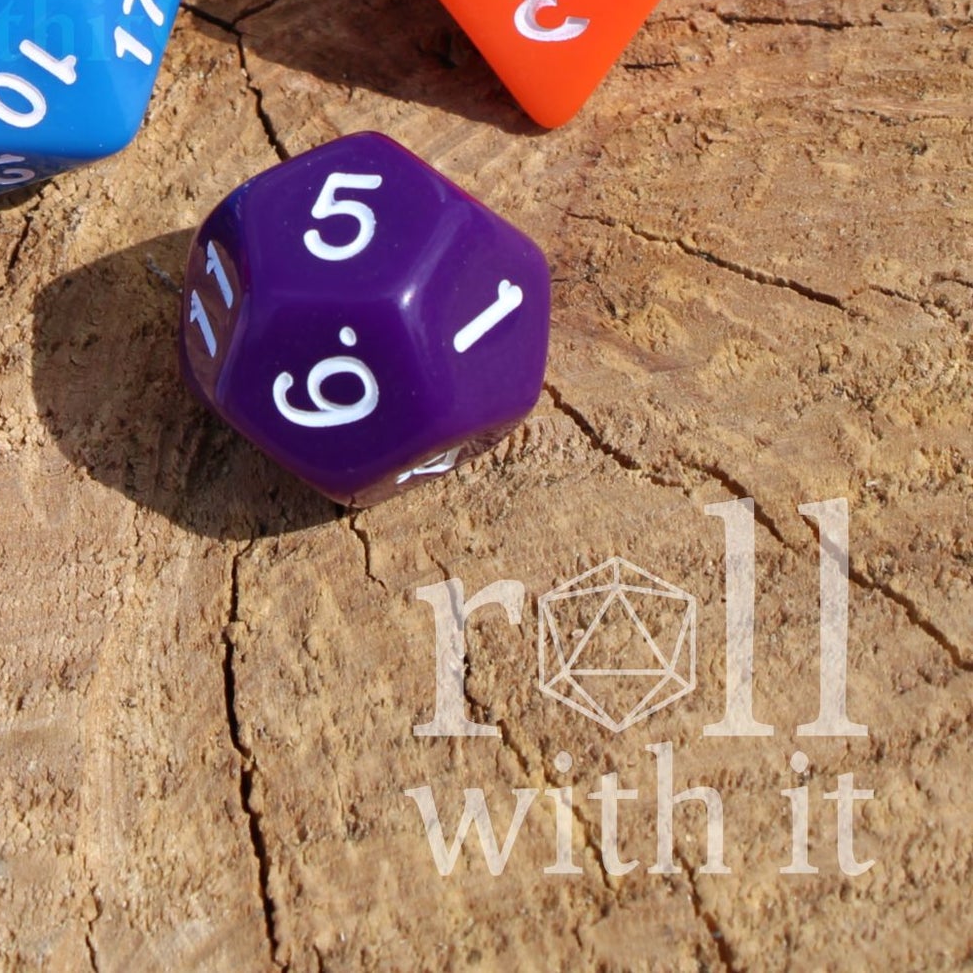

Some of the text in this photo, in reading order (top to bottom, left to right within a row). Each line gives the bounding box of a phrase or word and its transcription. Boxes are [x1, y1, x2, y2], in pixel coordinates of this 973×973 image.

[303, 172, 383, 261] 5
[190, 240, 234, 358] 11
[453, 279, 523, 353] 1
